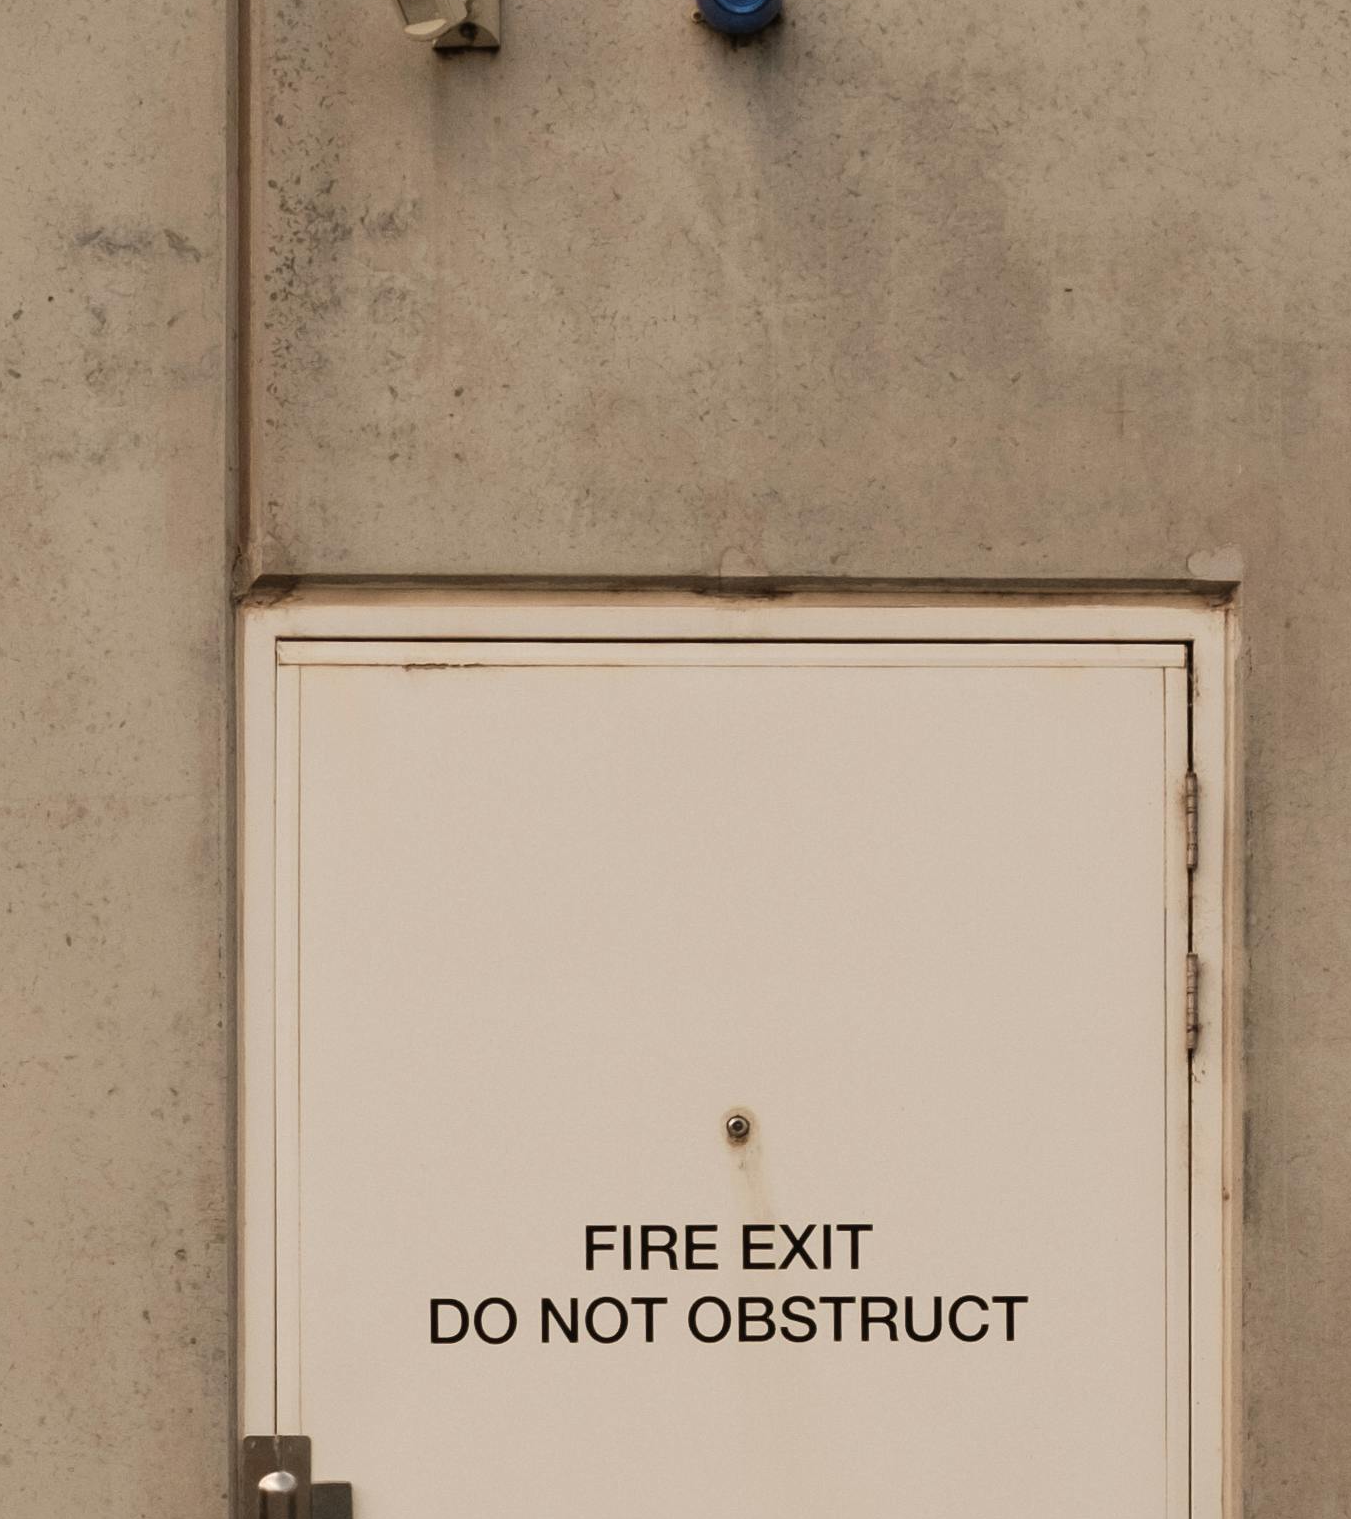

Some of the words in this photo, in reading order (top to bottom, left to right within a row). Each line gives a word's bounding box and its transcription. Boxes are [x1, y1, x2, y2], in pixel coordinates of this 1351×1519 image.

[584, 1223, 719, 1271] FIRE
[741, 1223, 874, 1270] EXIT
[428, 1297, 518, 1345] DO
[540, 1296, 668, 1344] NOT
[687, 1294, 1030, 1344] OBSTRUCT
